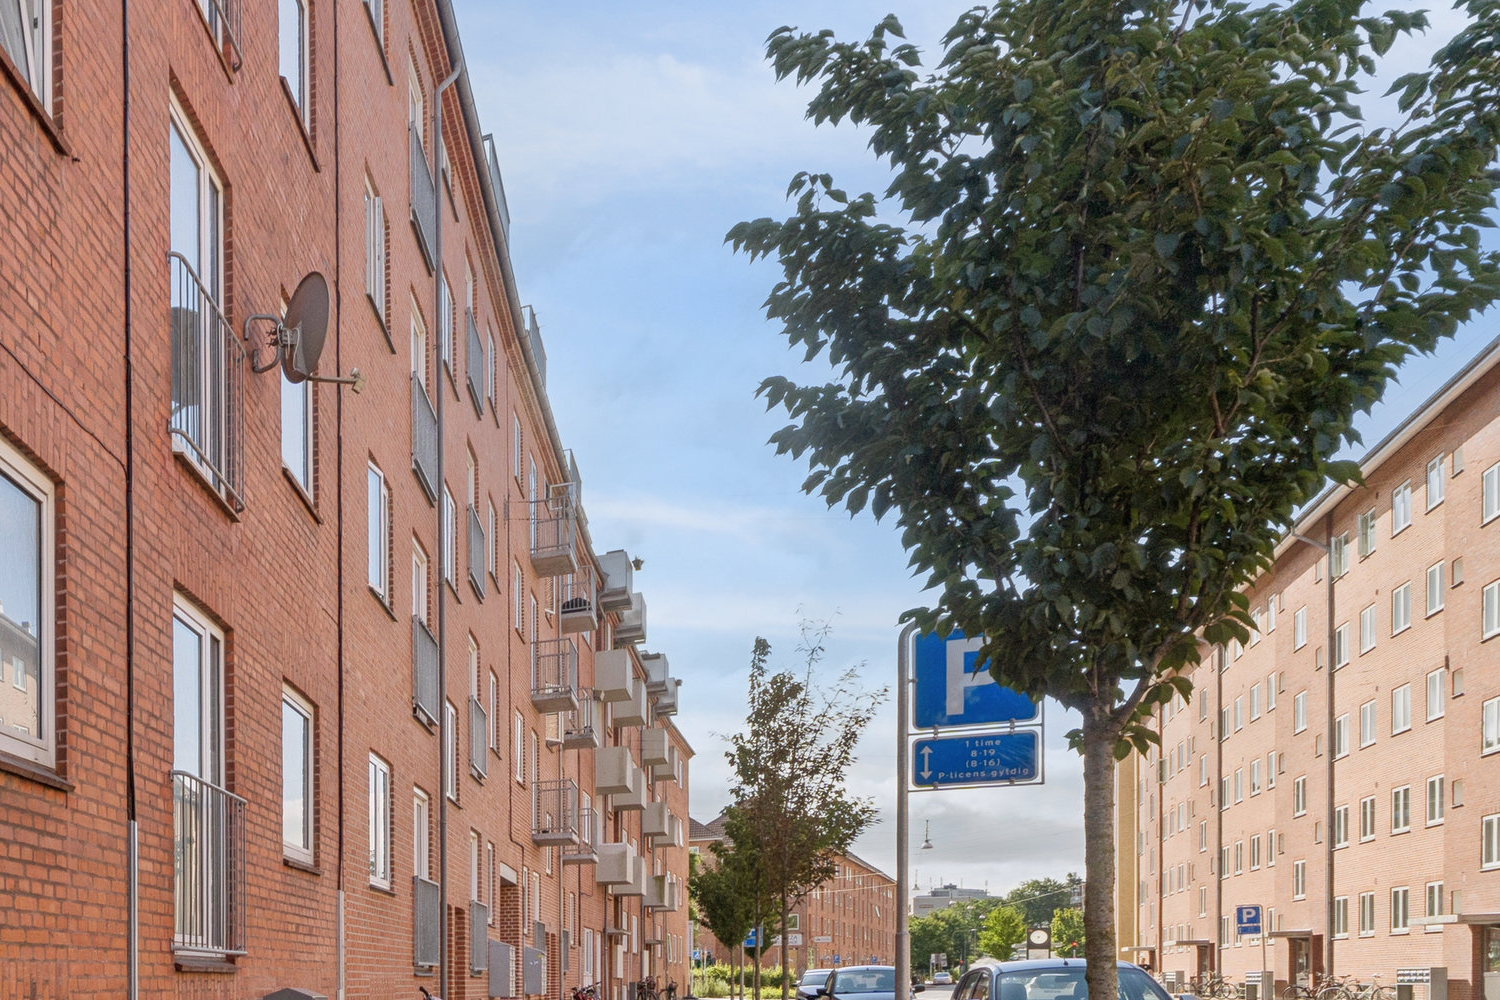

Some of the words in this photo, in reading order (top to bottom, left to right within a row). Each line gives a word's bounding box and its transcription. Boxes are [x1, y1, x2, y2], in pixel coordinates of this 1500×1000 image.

[946, 636, 998, 716] P
[965, 740, 970, 748] 1
[974, 739, 1001, 748] time
[1242, 908, 1256, 923] P
